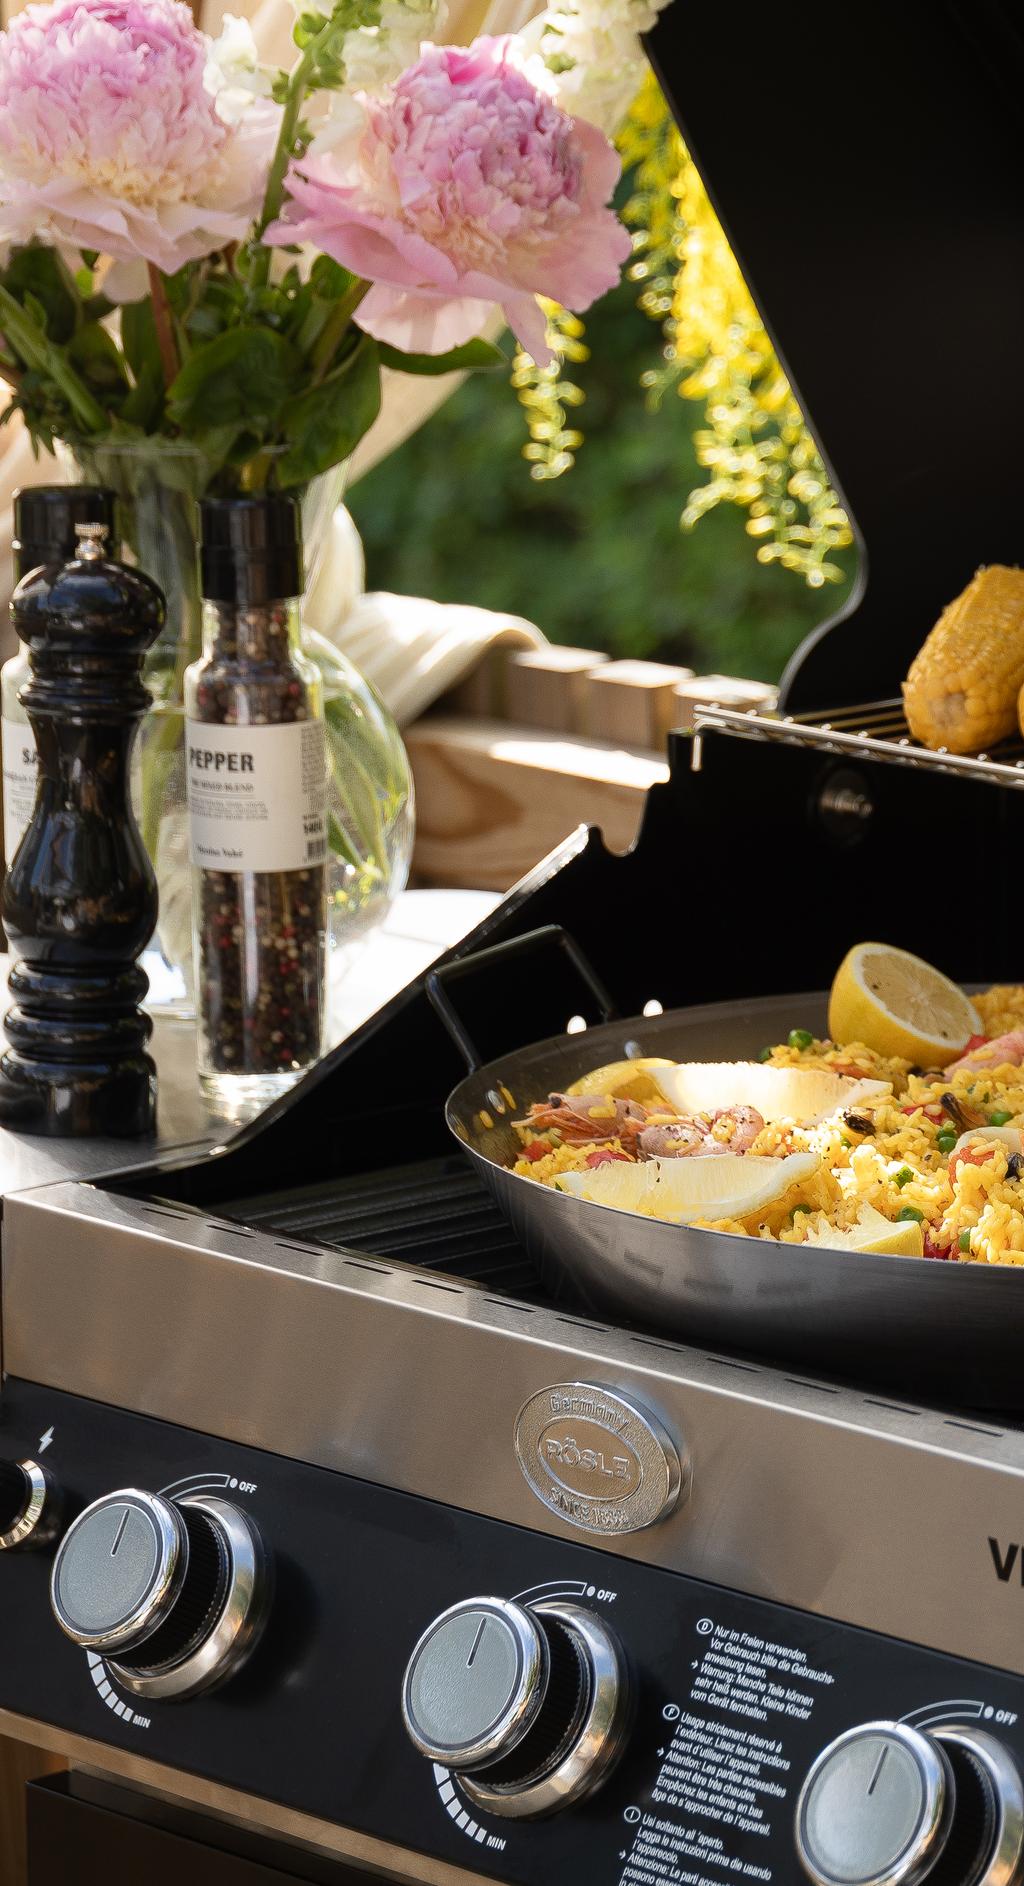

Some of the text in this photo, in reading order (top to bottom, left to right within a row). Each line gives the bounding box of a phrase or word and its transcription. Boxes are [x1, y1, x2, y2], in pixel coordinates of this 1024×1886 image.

[190, 746, 255, 773] PEPPER
[239, 1481, 258, 1493] OFF
[597, 1589, 617, 1602] OFF
[778, 1659, 790, 1671] die
[132, 1714, 151, 1728] MIN
[995, 1709, 1018, 1726] OFF
[486, 1835, 507, 1851] MIN
